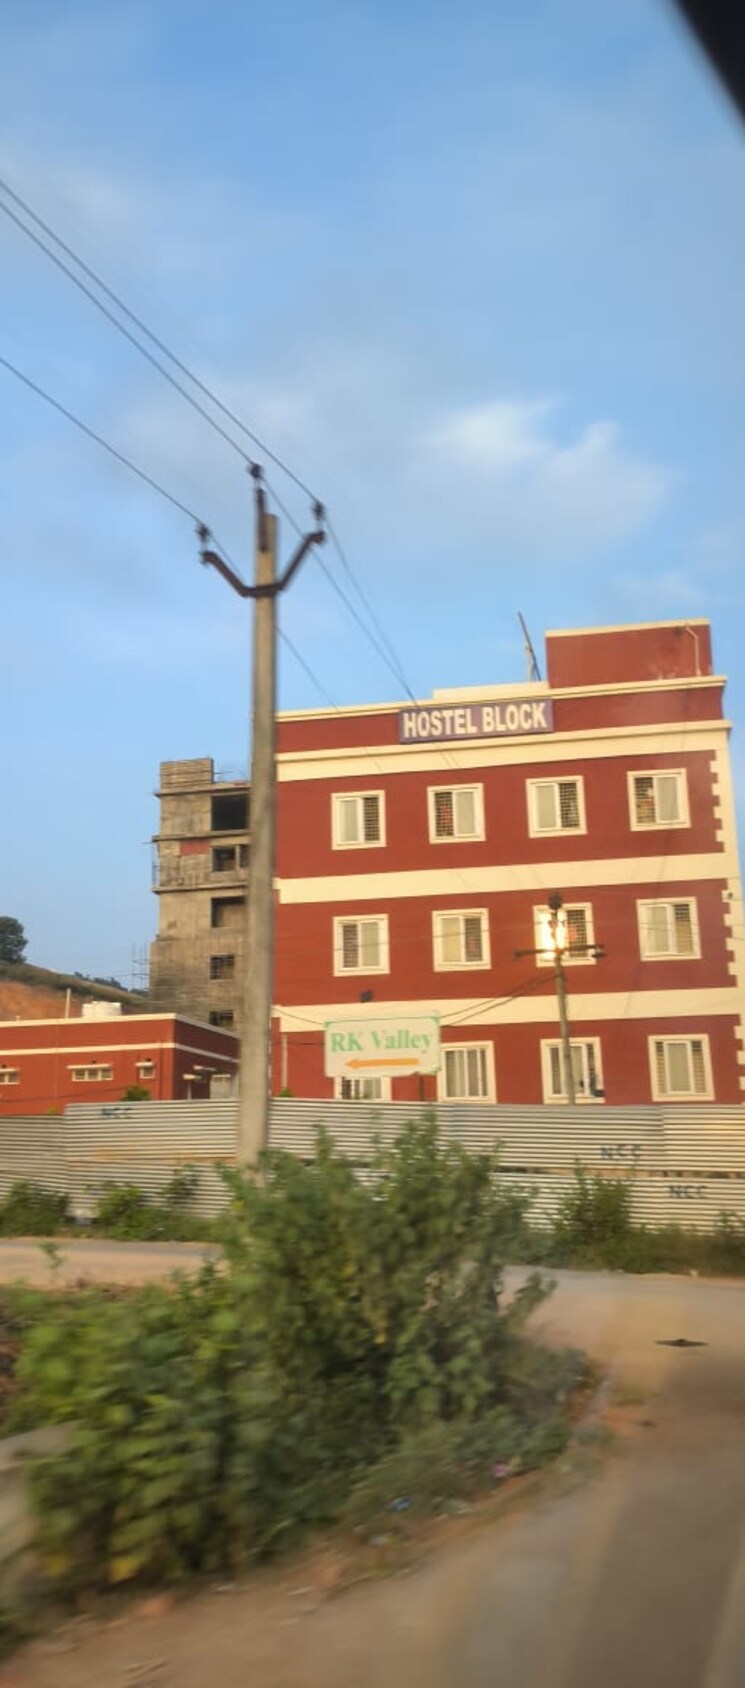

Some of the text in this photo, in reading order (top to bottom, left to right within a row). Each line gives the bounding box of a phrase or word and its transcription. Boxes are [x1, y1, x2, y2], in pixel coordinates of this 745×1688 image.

[403, 702, 548, 738] HOSTEL BLOCK
[331, 1029, 433, 1054] RK Valley
[600, 1143, 642, 1160] NCC
